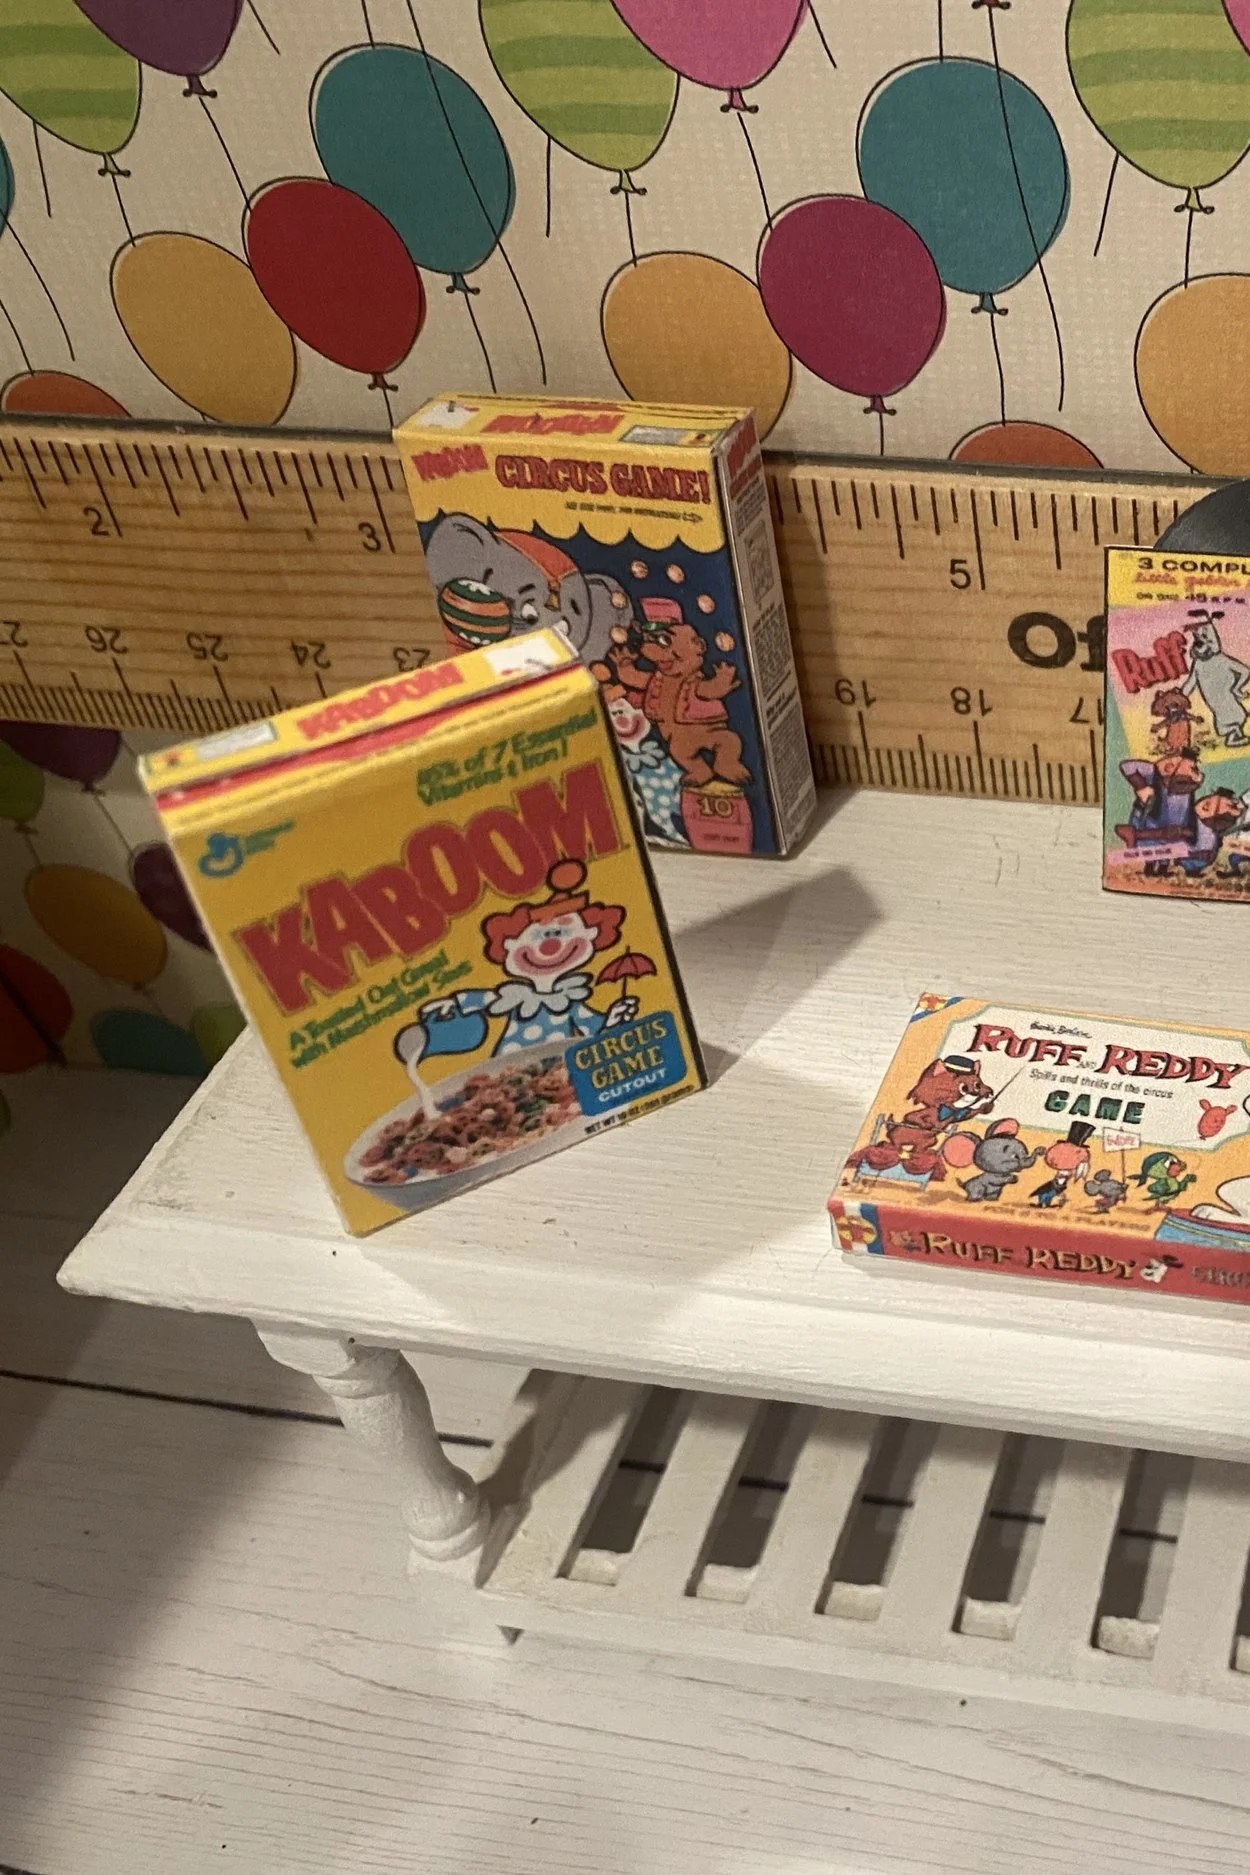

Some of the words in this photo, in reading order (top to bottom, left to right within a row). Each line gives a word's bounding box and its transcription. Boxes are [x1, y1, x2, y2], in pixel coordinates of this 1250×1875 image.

[495, 454, 608, 495] CIRCUS
[609, 463, 711, 504] GAME!
[83, 507, 110, 537] 2
[358, 522, 382, 552] 3
[949, 559, 972, 590] 5
[1138, 557, 1153, 570] 3
[84, 624, 127, 655] 26
[185, 631, 229, 662] 25
[289, 639, 332, 670] 24
[1111, 629, 1190, 694] Ruff
[298, 664, 464, 740] KABOOM
[834, 678, 877, 710] 19
[949, 686, 993, 717] 18
[700, 795, 734, 818] 10
[232, 760, 624, 1012] KABOOM
[289, 1030, 306, 1051] A
[574, 1018, 668, 1071] CIRCUS
[966, 1023, 1088, 1066] RUFF
[591, 1045, 664, 1090] GAME
[598, 1067, 666, 1102] CUTOUT
[1059, 1074, 1079, 1086] and
[1081, 1075, 1110, 1090] thrills
[1111, 1079, 1124, 1091] of
[1125, 1082, 1141, 1095] the
[1142, 1088, 1174, 1099] circus
[1044, 1089, 1146, 1125] GAME
[1077, 1217, 1150, 1232] PLAYERS
